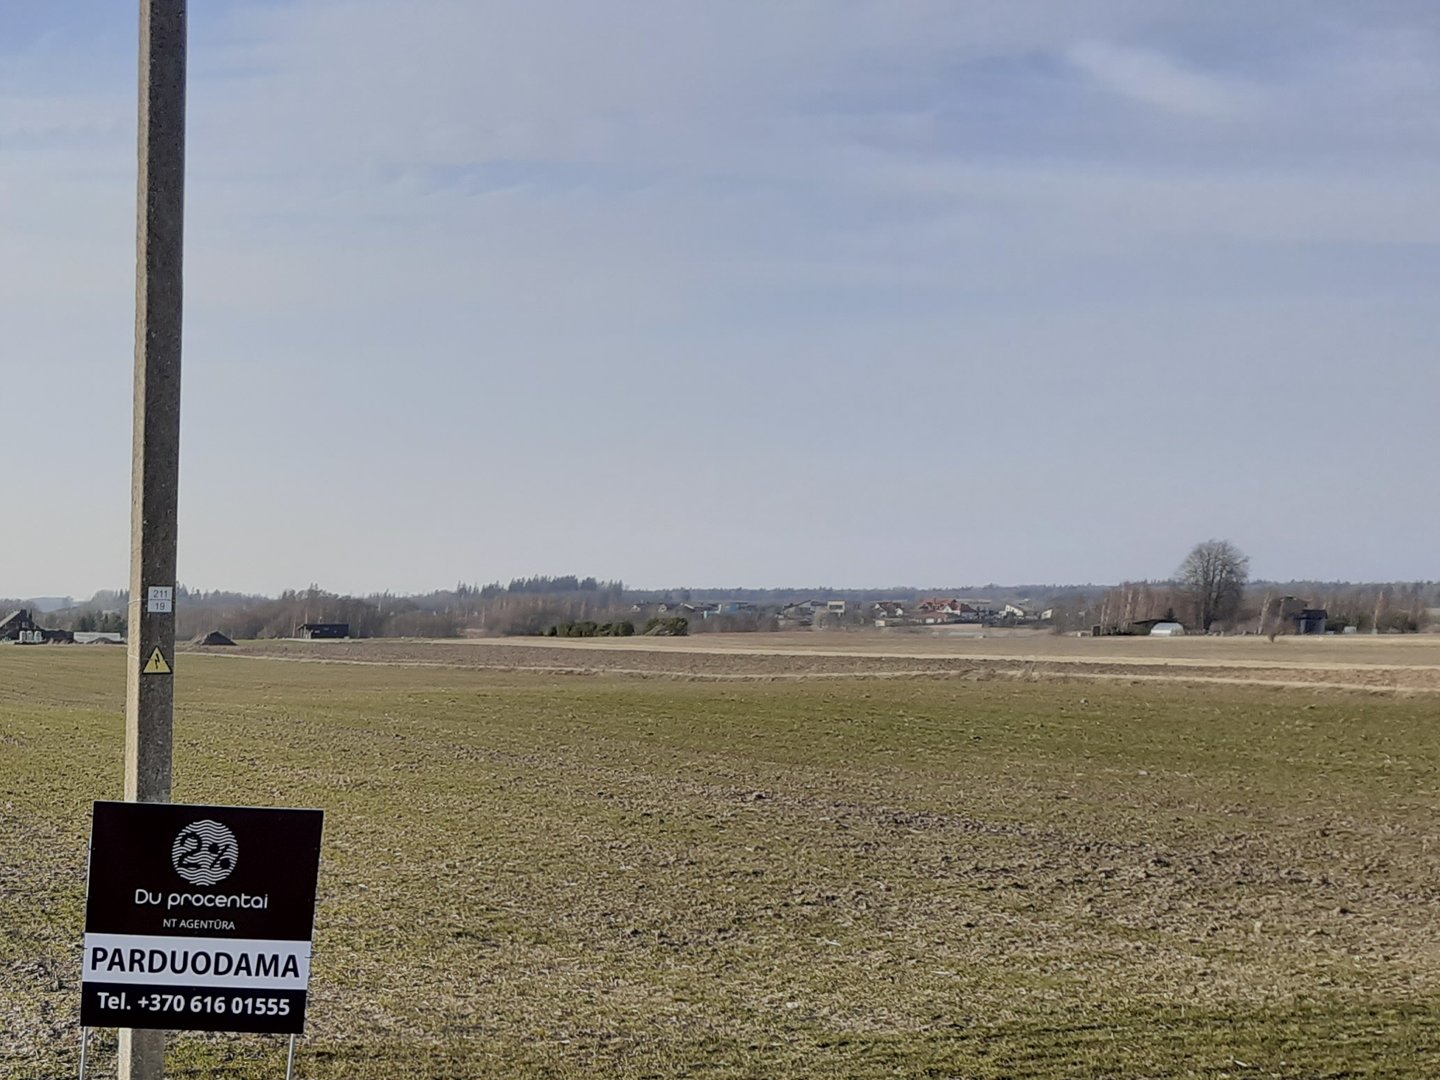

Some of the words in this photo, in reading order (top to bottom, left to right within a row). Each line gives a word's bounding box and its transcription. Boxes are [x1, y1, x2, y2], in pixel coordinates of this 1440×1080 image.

[153, 590, 168, 598] 211
[156, 602, 165, 610] 19
[134, 889, 162, 905] Du
[167, 893, 268, 910] procentai
[163, 918, 177, 928] NT
[179, 919, 236, 930] AGENTŪRA
[91, 947, 300, 978] PARDUODAMA
[97, 992, 131, 1010] Tel.
[137, 994, 185, 1012] +370
[190, 996, 226, 1014] 616
[231, 997, 290, 1015] 01555
